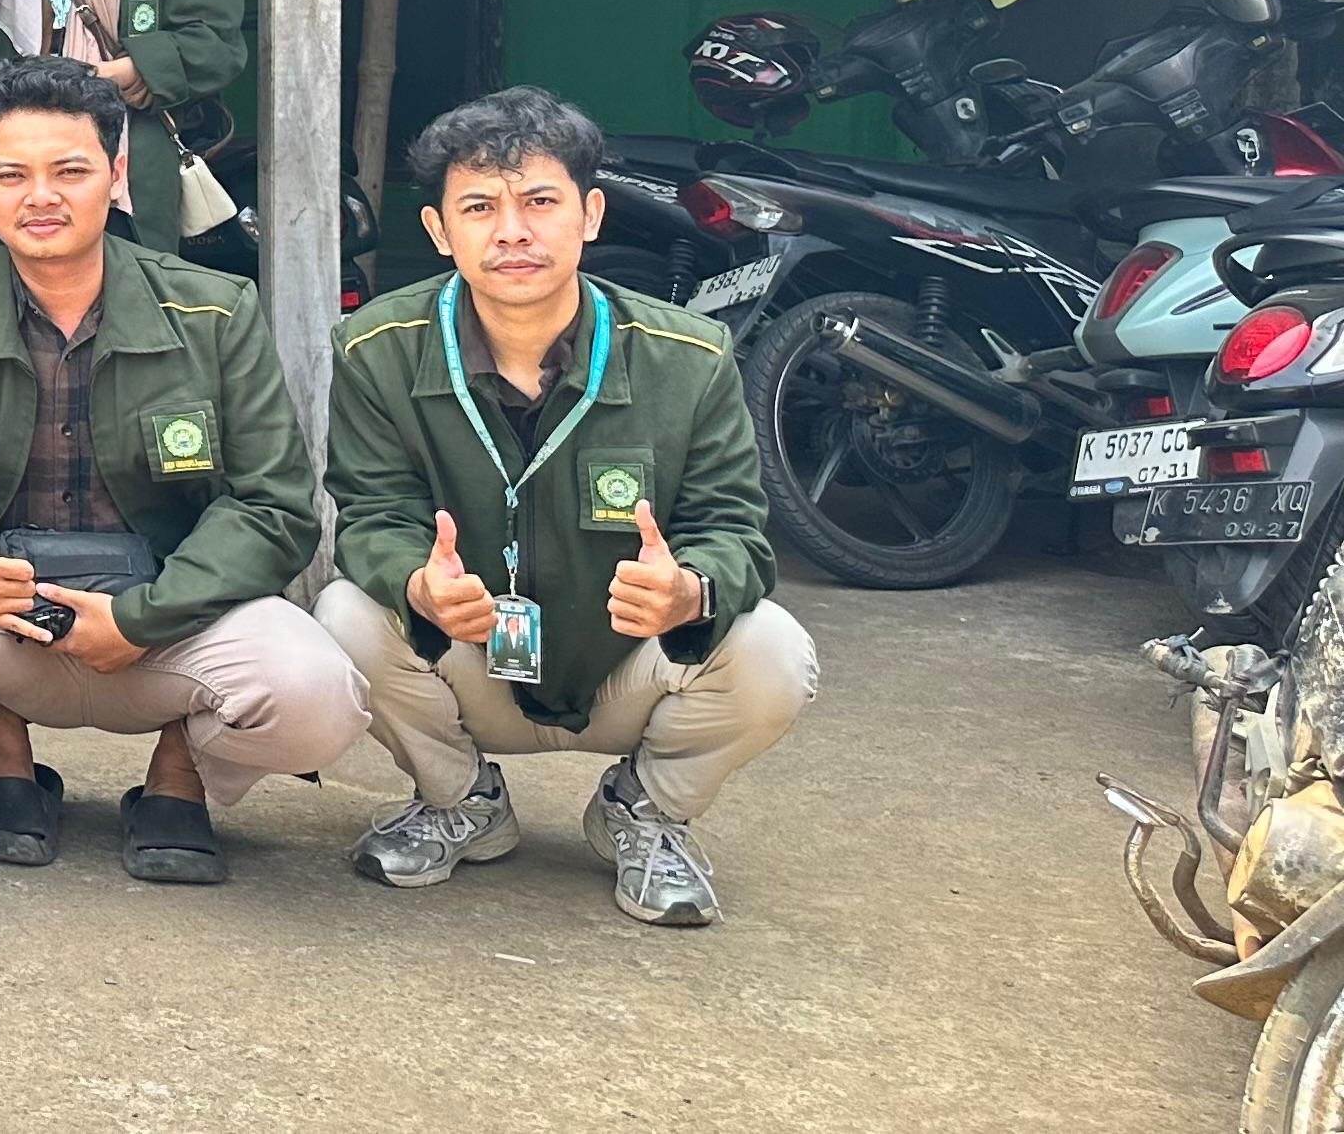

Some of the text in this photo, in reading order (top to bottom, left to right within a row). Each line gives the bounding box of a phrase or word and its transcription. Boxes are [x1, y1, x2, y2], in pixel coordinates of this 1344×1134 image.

[1083, 437, 1096, 461] K
[1105, 431, 1154, 460] 5937
[1150, 484, 1306, 515] K 5436 XQ
